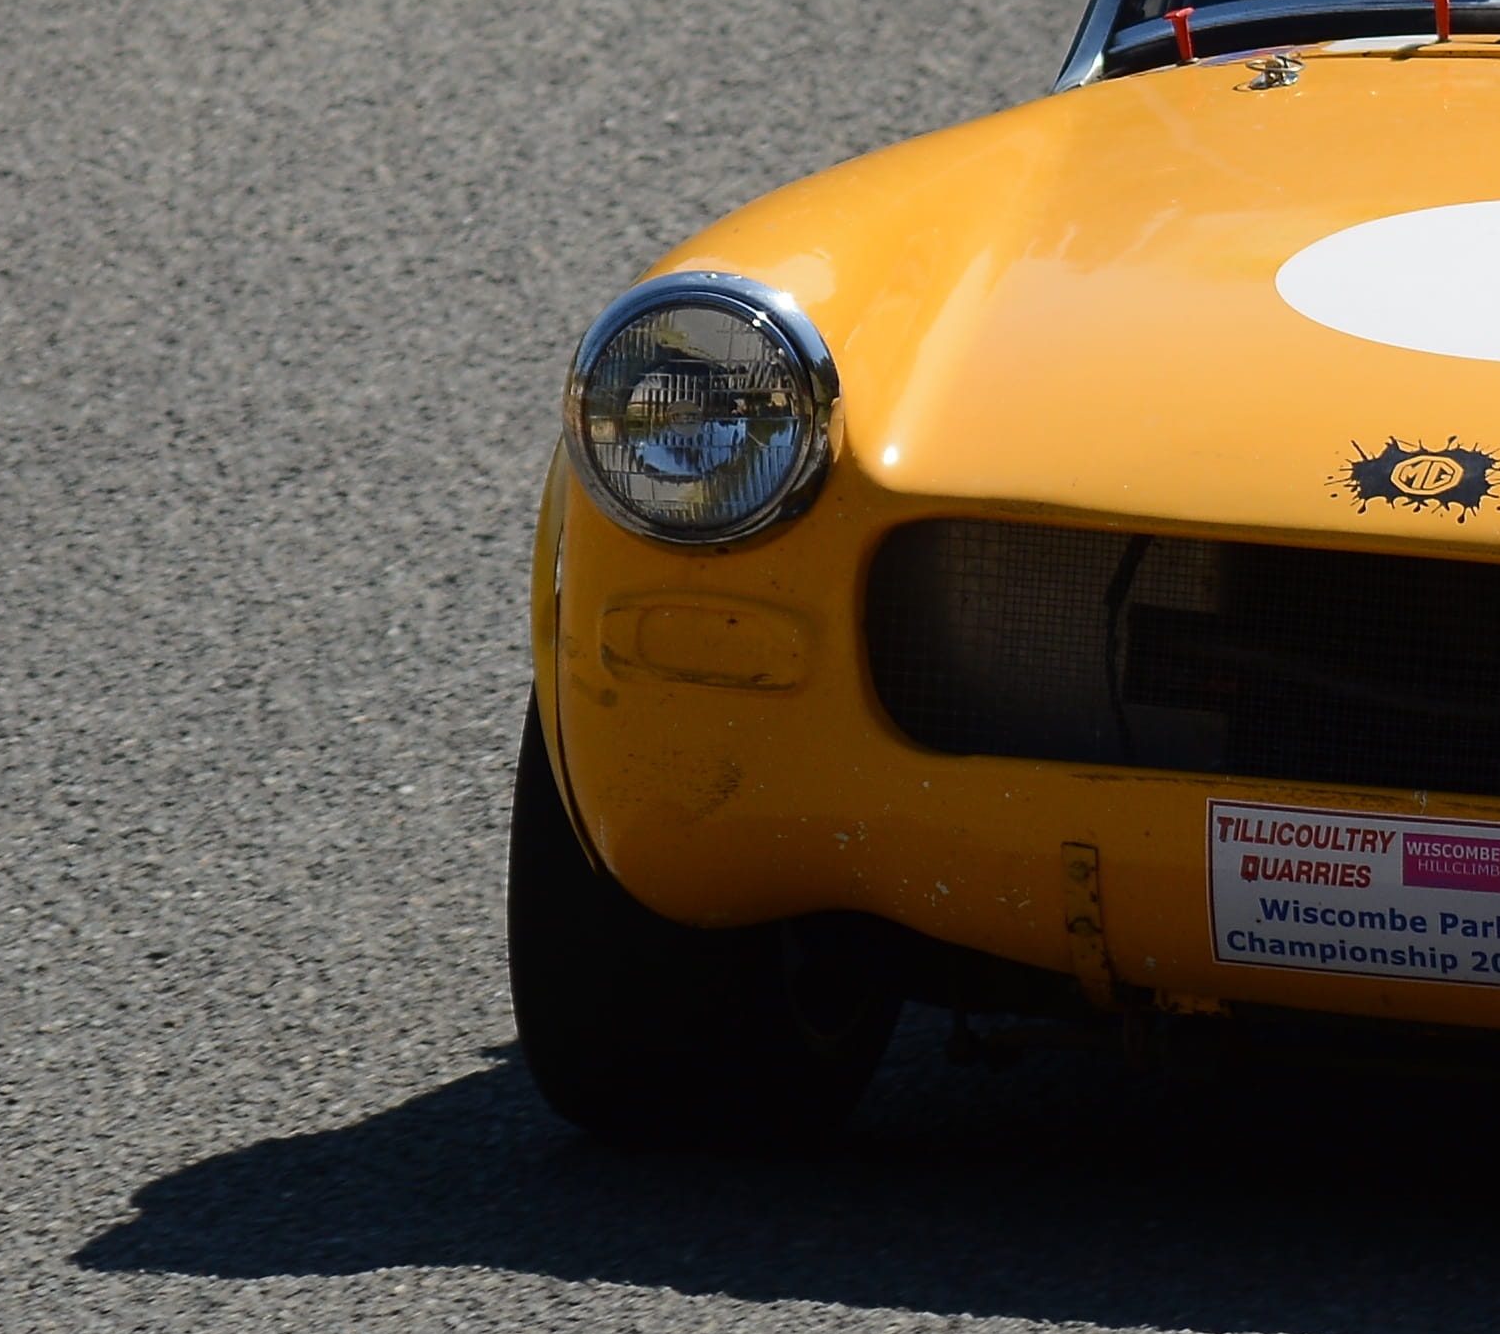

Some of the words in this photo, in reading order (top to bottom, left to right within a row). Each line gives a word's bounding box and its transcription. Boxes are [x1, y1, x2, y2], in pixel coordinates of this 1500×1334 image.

[1397, 459, 1457, 492] MG
[1216, 816, 1396, 854] TILLICOULTRY
[1406, 841, 1500, 861] WISCOMBE
[1240, 854, 1371, 888] QUARRIES
[1417, 858, 1500, 878] HILLCLIMB
[1259, 897, 1427, 933] Wiscombe
[1227, 930, 1458, 972] Championship
